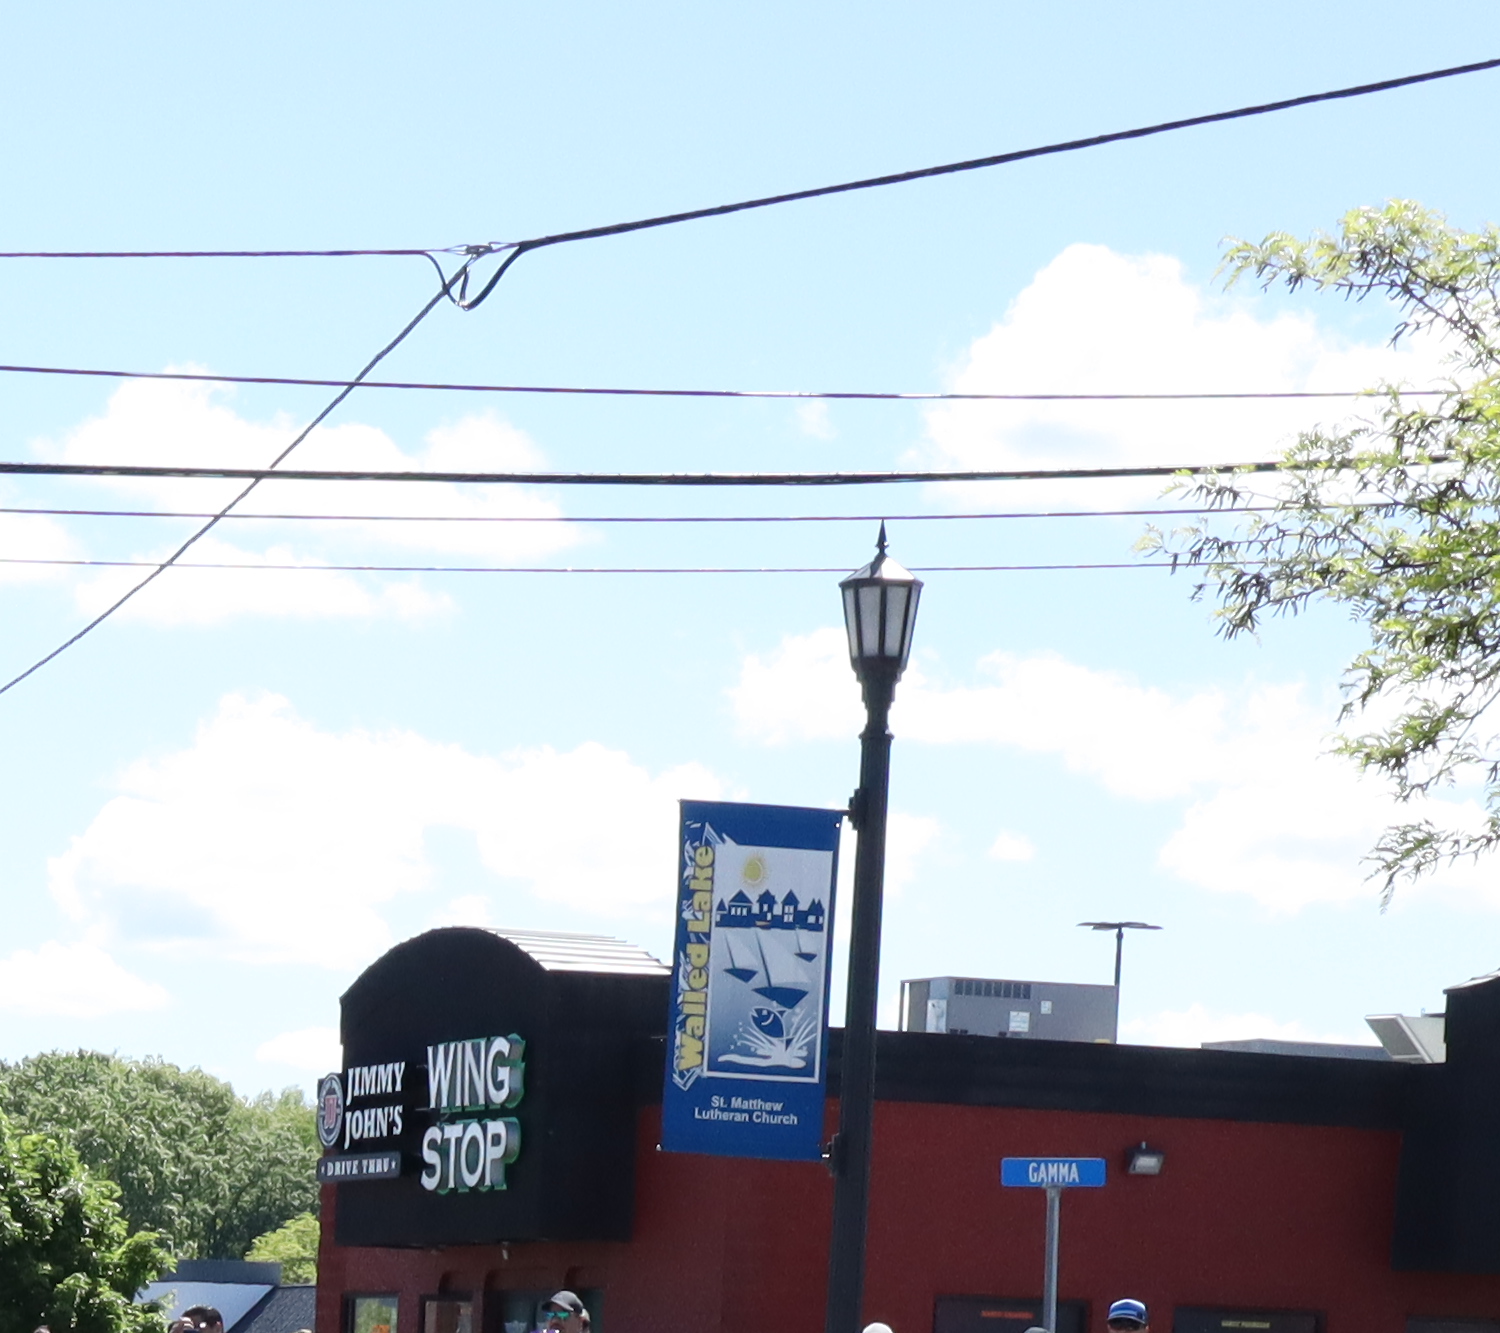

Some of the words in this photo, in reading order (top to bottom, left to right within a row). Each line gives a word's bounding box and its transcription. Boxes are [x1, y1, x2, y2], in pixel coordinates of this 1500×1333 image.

[687, 844, 716, 934] Lake
[680, 942, 711, 1071] Walled
[345, 1060, 406, 1107] JIMMY
[426, 1035, 511, 1110] WING
[694, 1106, 750, 1124] Lutheran
[752, 1110, 798, 1126] Church
[710, 1095, 728, 1110] St.
[730, 1096, 784, 1112] Matthew
[343, 1104, 404, 1151] JOHN'S
[326, 1161, 359, 1177] DRIVE
[361, 1157, 390, 1174] THRU
[420, 1120, 507, 1192] STOP
[1028, 1161, 1080, 1184] GAMMA
